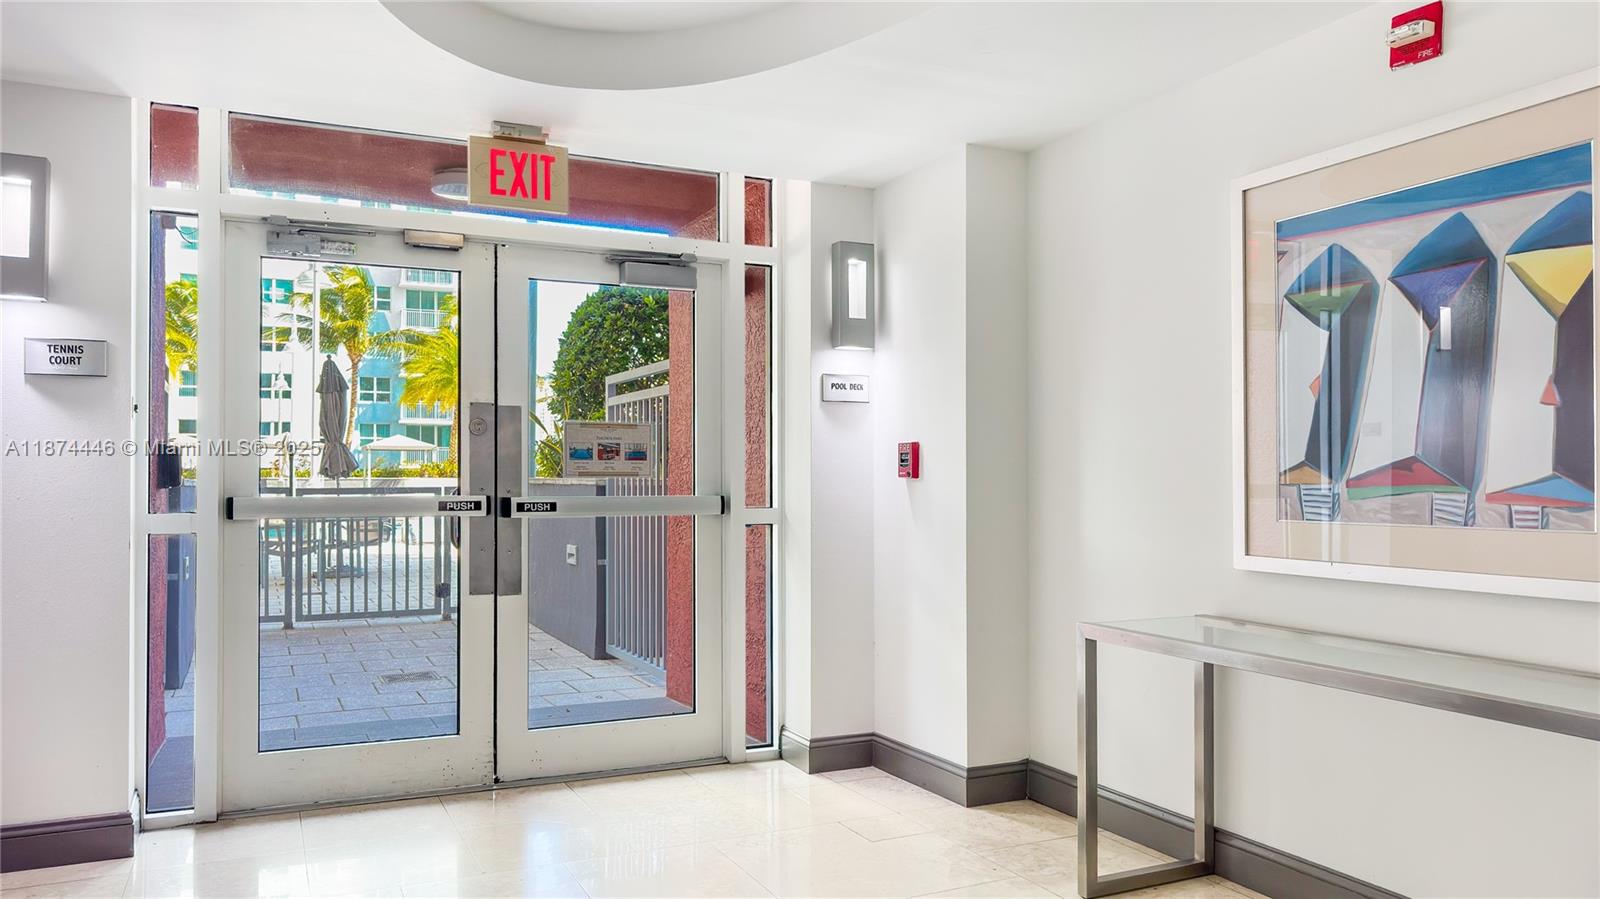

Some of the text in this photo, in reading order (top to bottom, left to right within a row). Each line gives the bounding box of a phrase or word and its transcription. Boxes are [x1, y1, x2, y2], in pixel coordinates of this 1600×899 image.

[1417, 48, 1434, 59] FIRE
[489, 148, 556, 201] EXIT
[46, 344, 84, 354] TENNIS
[48, 355, 82, 365] COURT
[831, 382, 864, 391] POOL DECK
[446, 502, 475, 511] PUSH
[524, 503, 551, 511] PUSH
